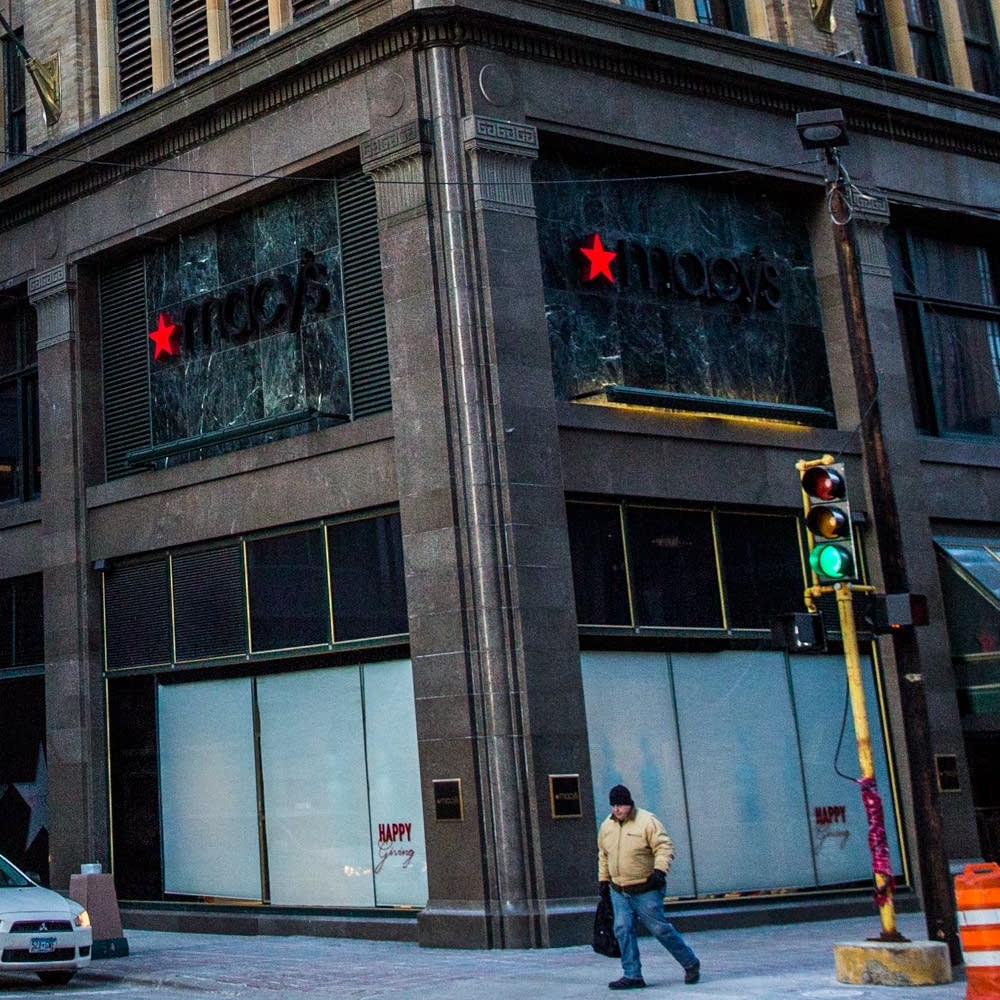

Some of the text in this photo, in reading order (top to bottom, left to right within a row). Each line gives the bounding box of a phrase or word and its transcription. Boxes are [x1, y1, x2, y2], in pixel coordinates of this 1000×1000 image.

[815, 805, 846, 824] HAPPY
[378, 823, 412, 842] HAPPY
[374, 841, 415, 874] Giving
